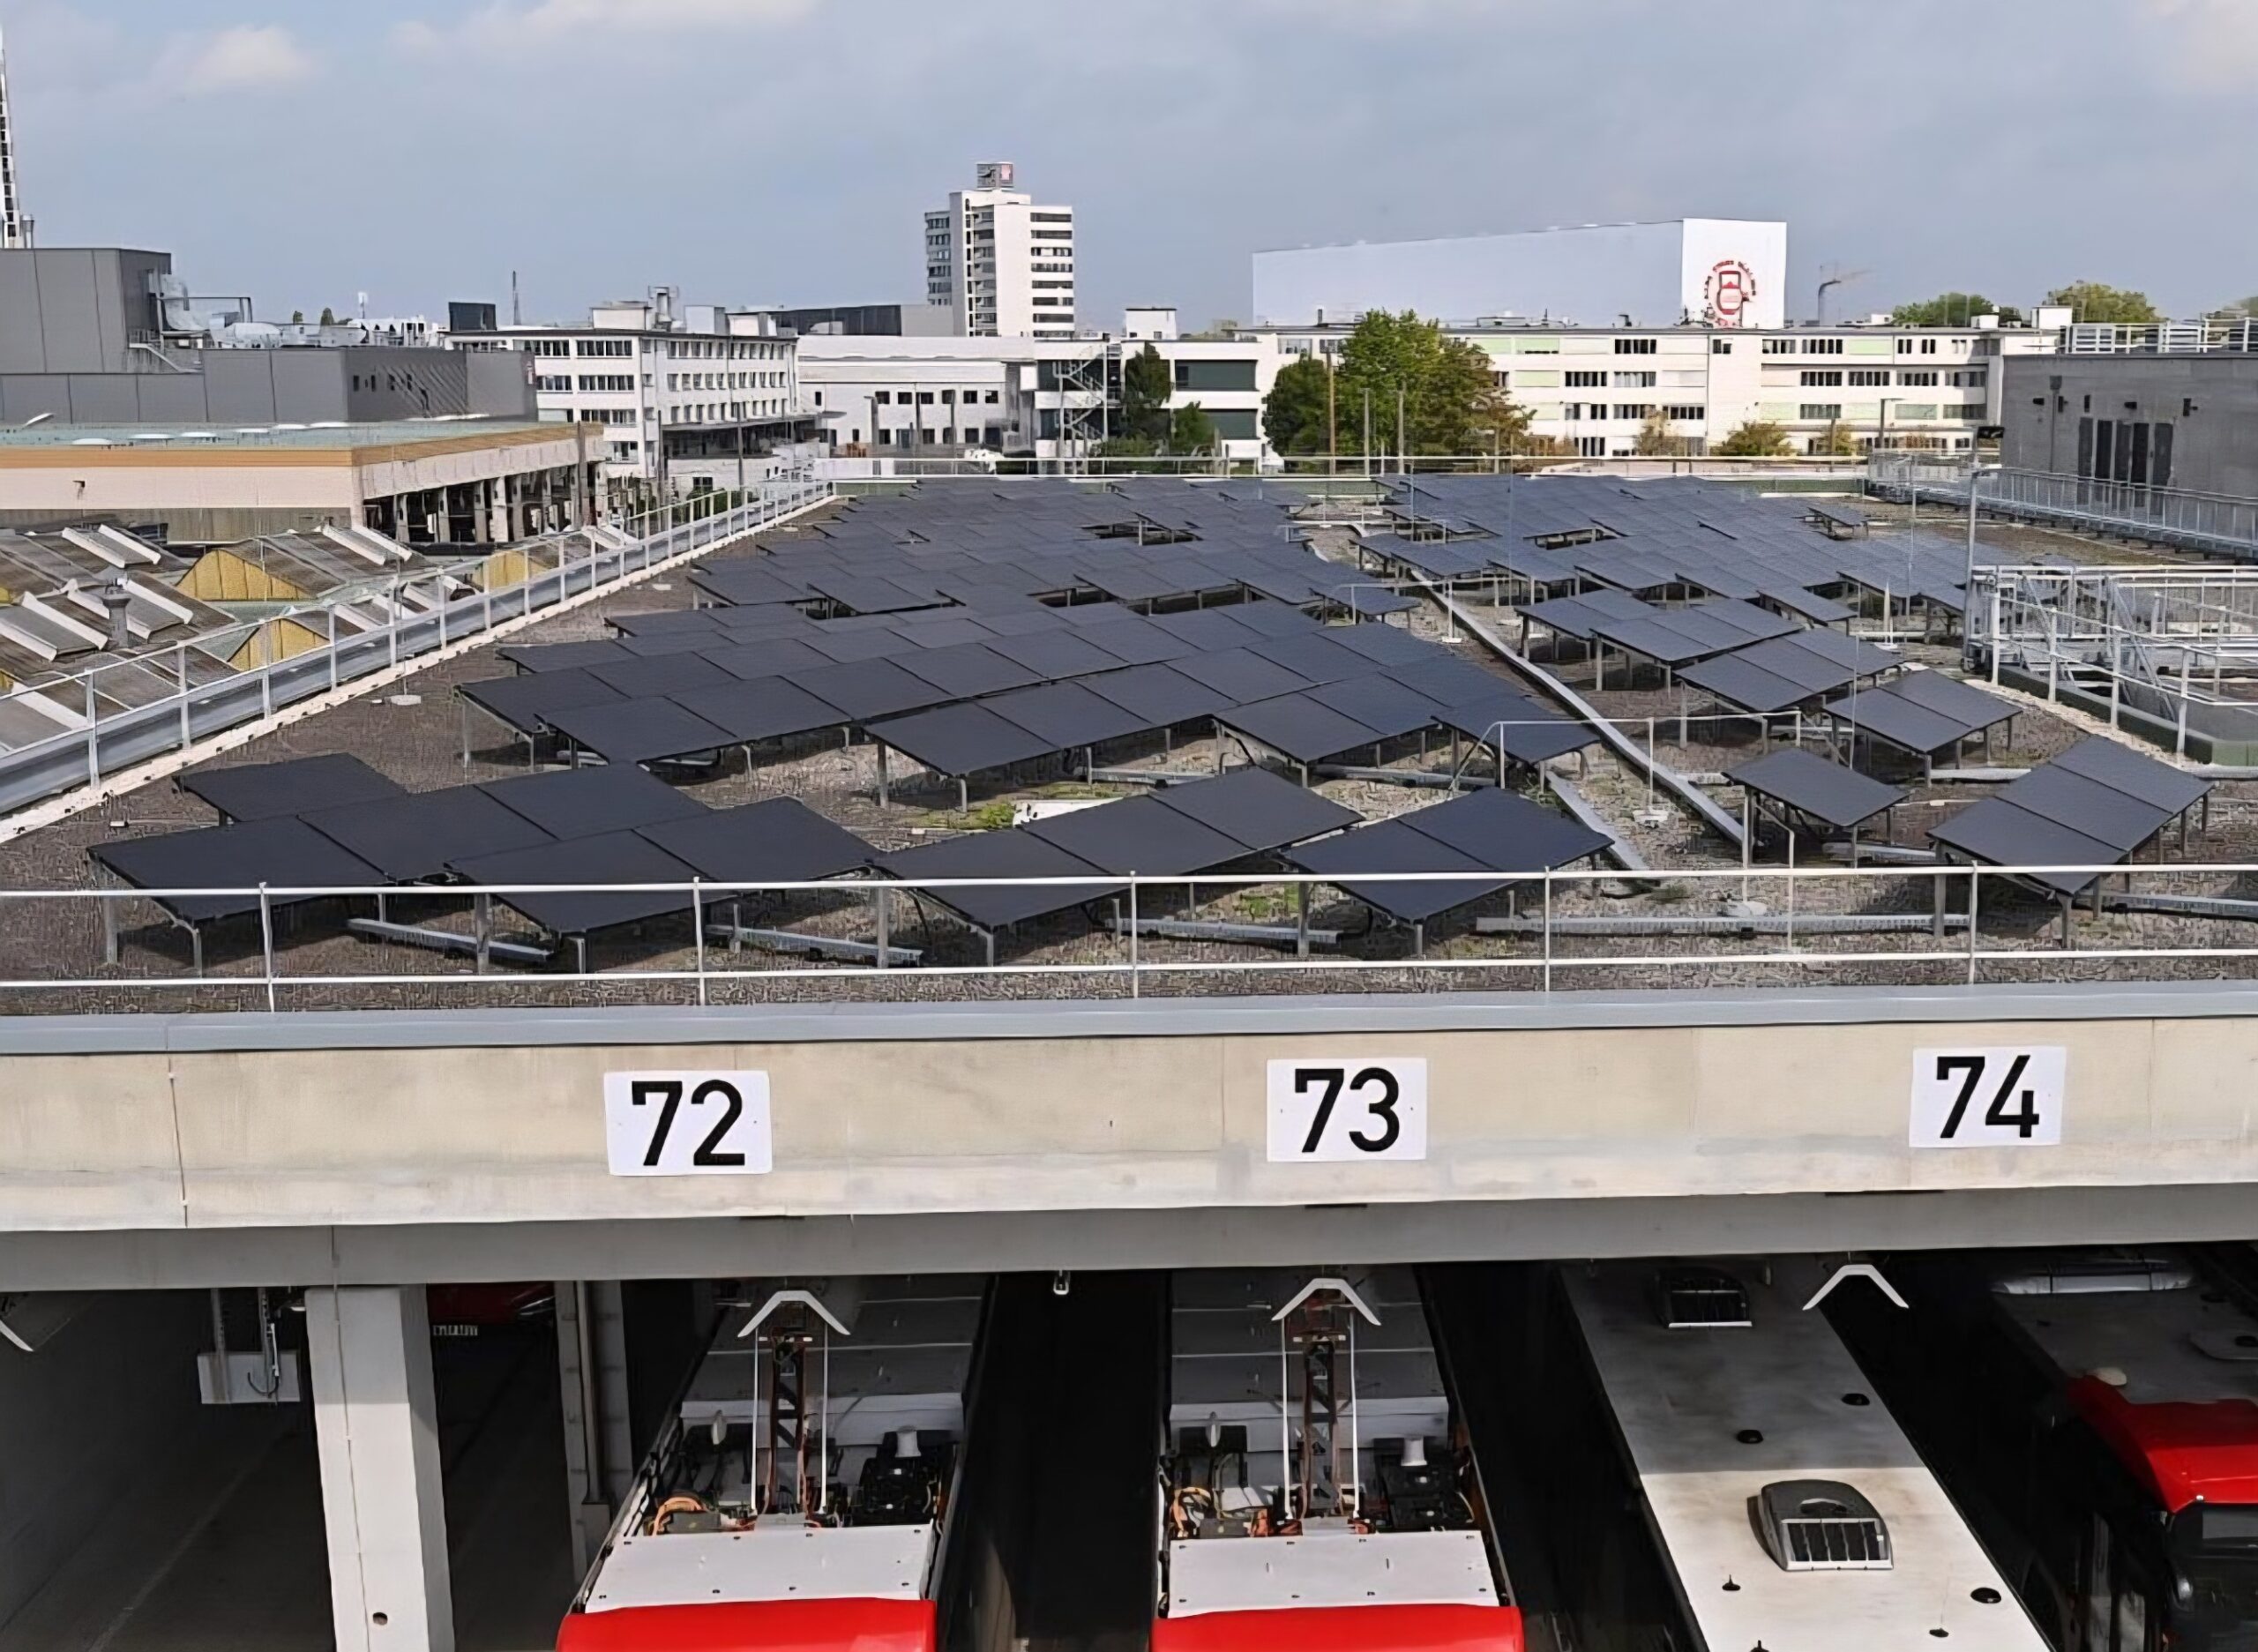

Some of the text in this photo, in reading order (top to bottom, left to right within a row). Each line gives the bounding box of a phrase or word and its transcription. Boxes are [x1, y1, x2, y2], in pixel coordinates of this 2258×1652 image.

[632, 1079, 745, 1167] 72
[1295, 1067, 1400, 1153] 73
[1936, 1055, 2040, 1139] 74
